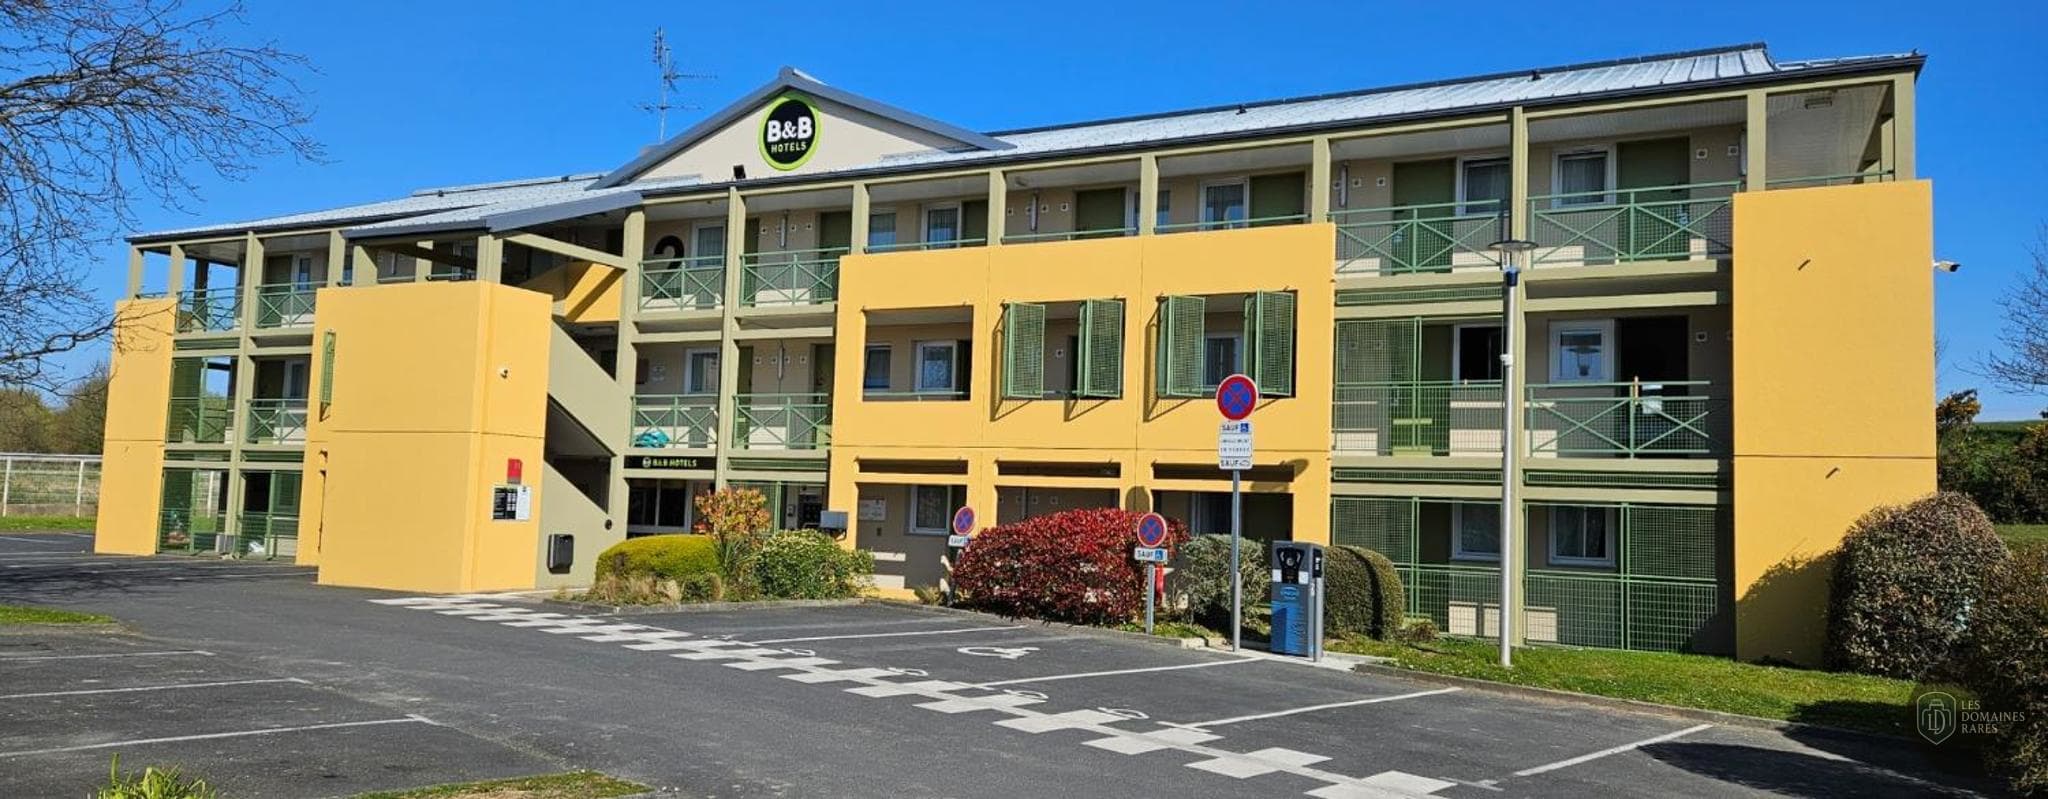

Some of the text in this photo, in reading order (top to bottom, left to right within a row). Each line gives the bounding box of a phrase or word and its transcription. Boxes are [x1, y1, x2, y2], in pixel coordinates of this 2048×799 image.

[767, 116, 812, 142] B&B
[770, 141, 807, 153] HOTELS
[669, 459, 697, 467] HOTELS
